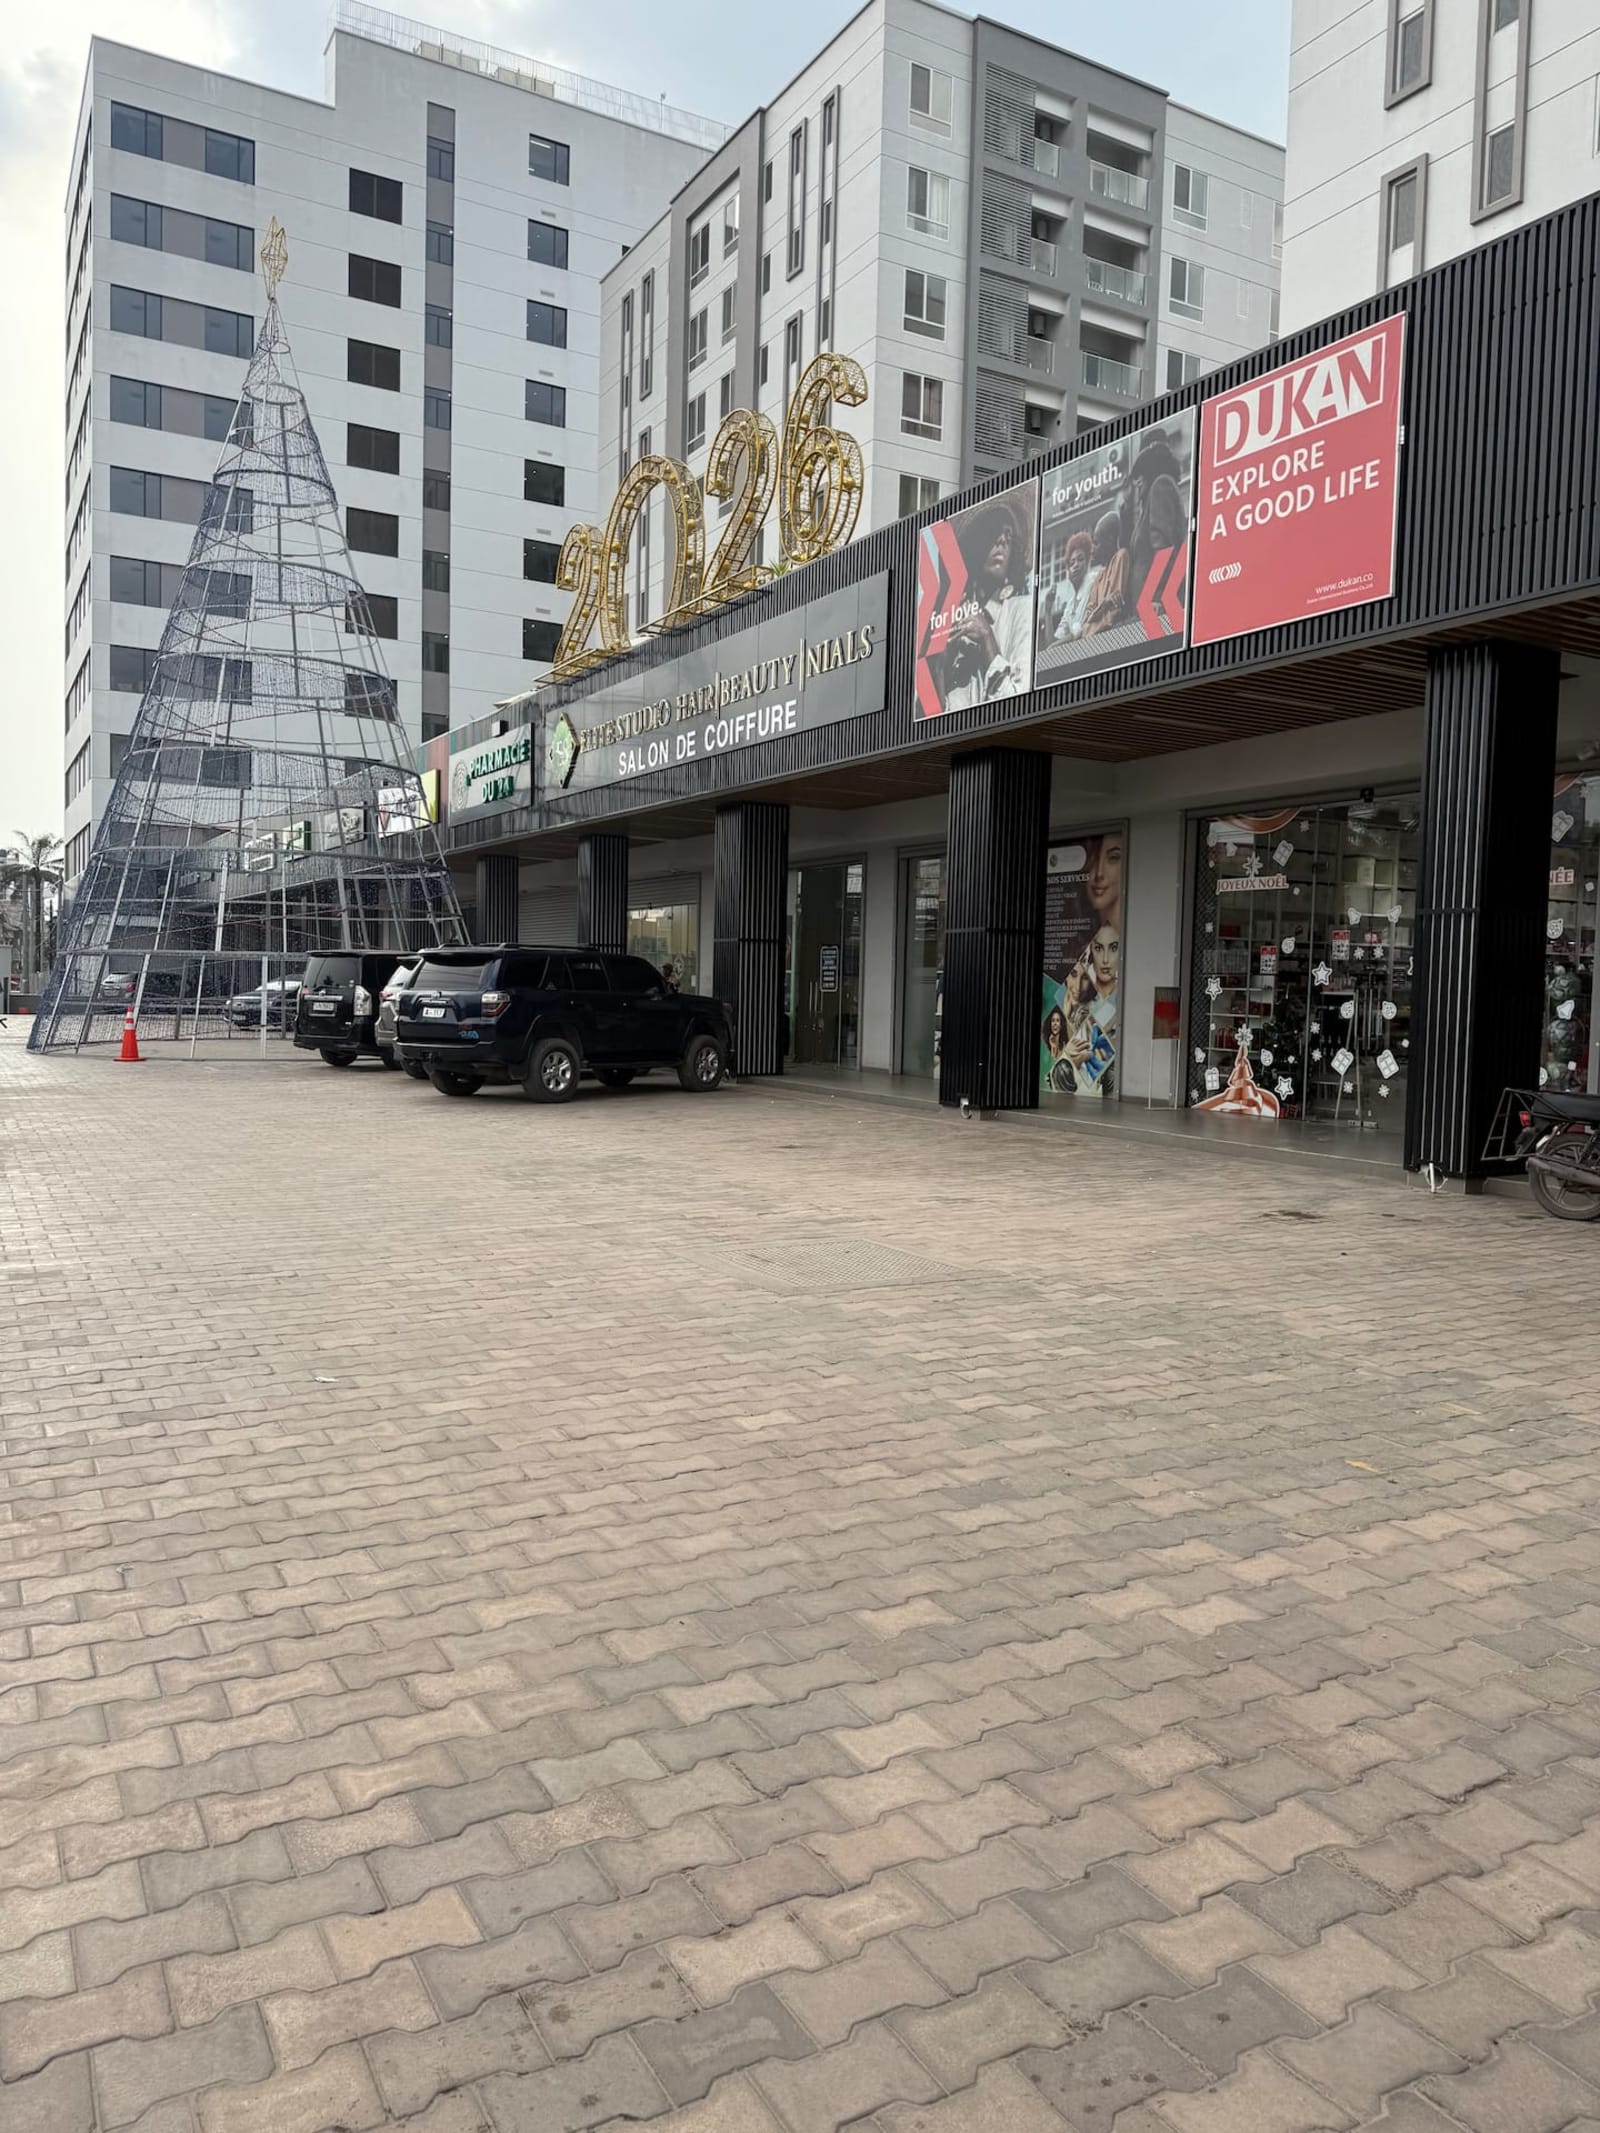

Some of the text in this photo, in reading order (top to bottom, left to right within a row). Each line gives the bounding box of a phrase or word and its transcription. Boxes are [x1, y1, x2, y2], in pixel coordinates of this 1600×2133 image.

[1215, 333, 1386, 467] DUKAN
[1052, 486, 1074, 506] for
[1075, 463, 1123, 500] youth.
[1211, 440, 1326, 505] EXPLORE
[547, 352, 869, 676] 2026
[1210, 459, 1381, 541] A GOOD LIFE
[1315, 572, 1374, 595] www.dukan.co
[930, 601, 982, 630] for love.
[616, 699, 671, 741] STUDIO
[719, 653, 798, 707] BEAUTY
[806, 624, 874, 678] NIALS
[470, 739, 530, 779] PHARMACIE
[618, 699, 797, 776] SALON DE COIFFURE
[482, 780, 496, 803] DU
[1217, 879, 1256, 893] JOYEUX
